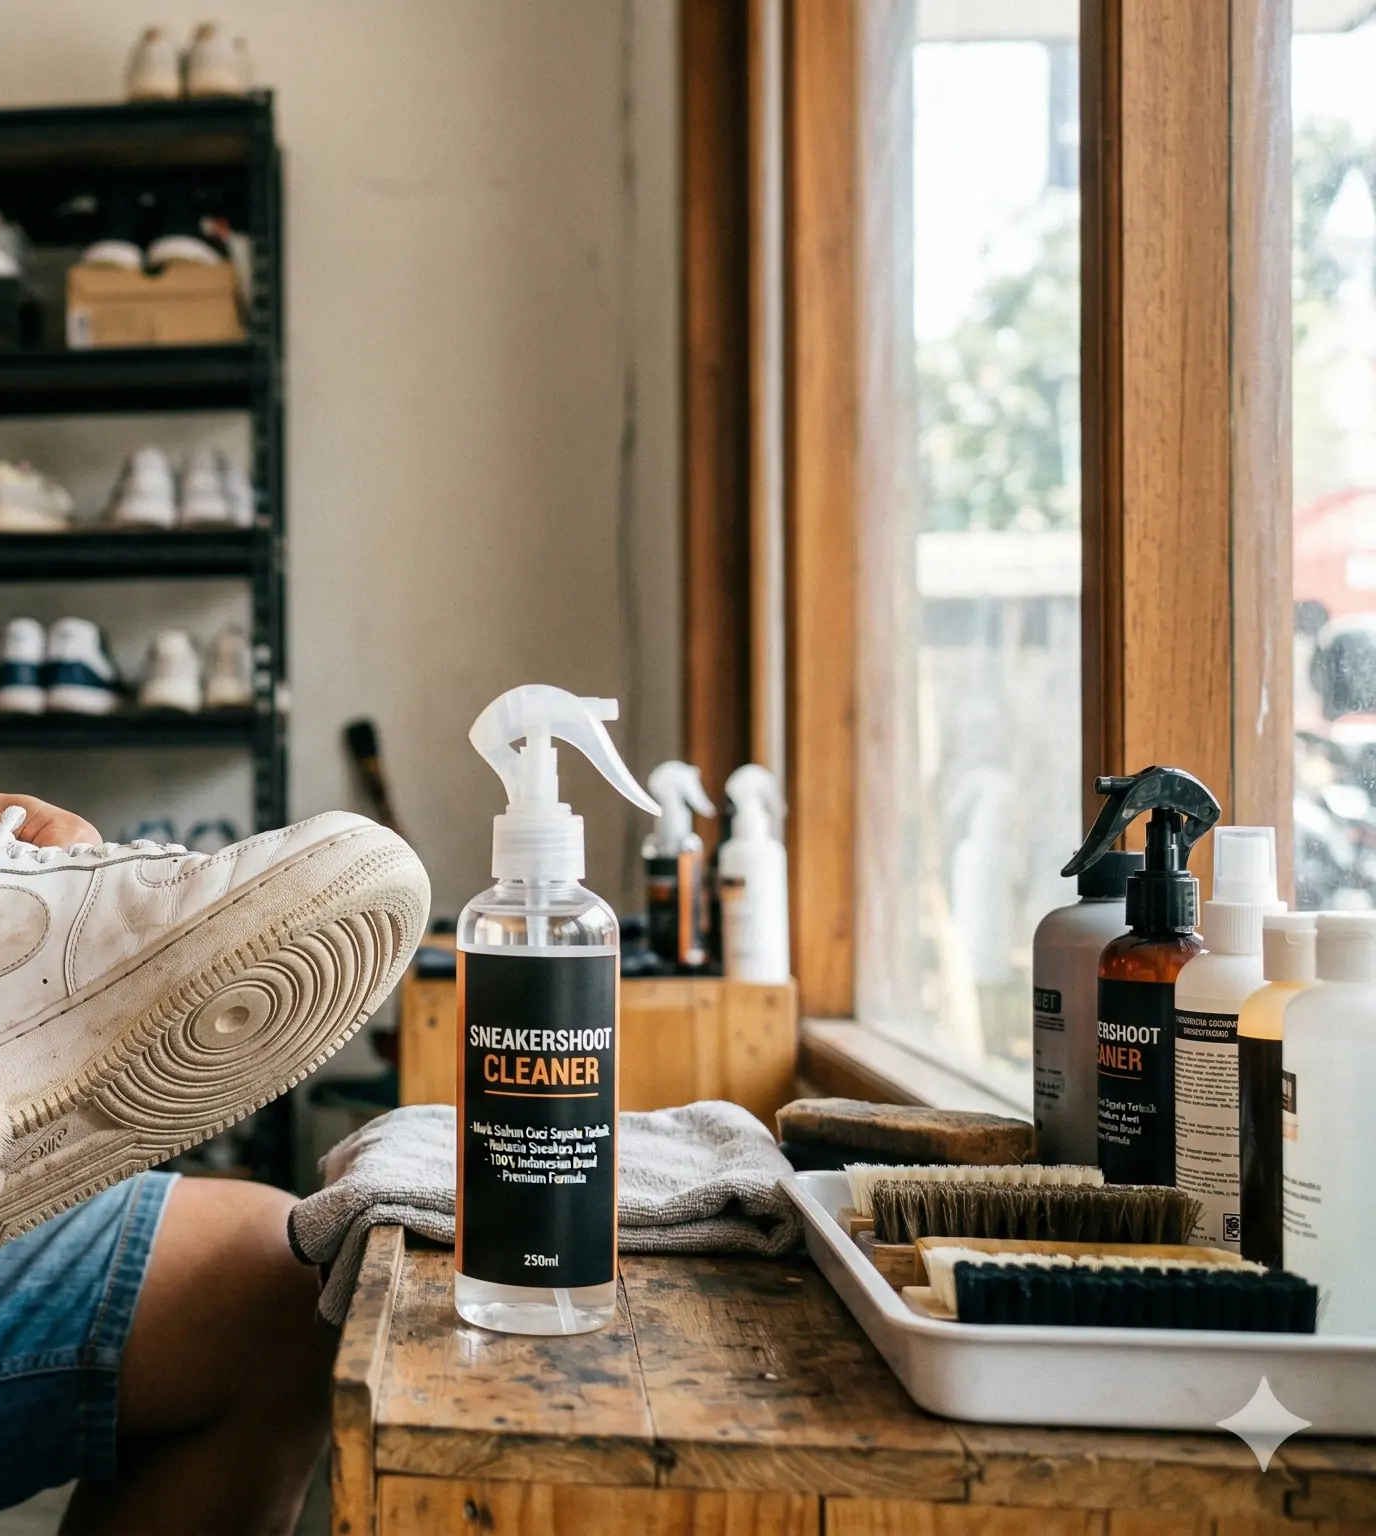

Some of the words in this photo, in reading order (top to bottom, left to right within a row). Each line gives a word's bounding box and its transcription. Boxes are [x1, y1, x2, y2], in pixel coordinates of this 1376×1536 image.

[469, 1024, 612, 1052] SNEAKERSHOOT
[484, 1053, 599, 1086] CLEANER
[1098, 1043, 1143, 1071] ANER
[524, 1254, 559, 1267] 250ml
